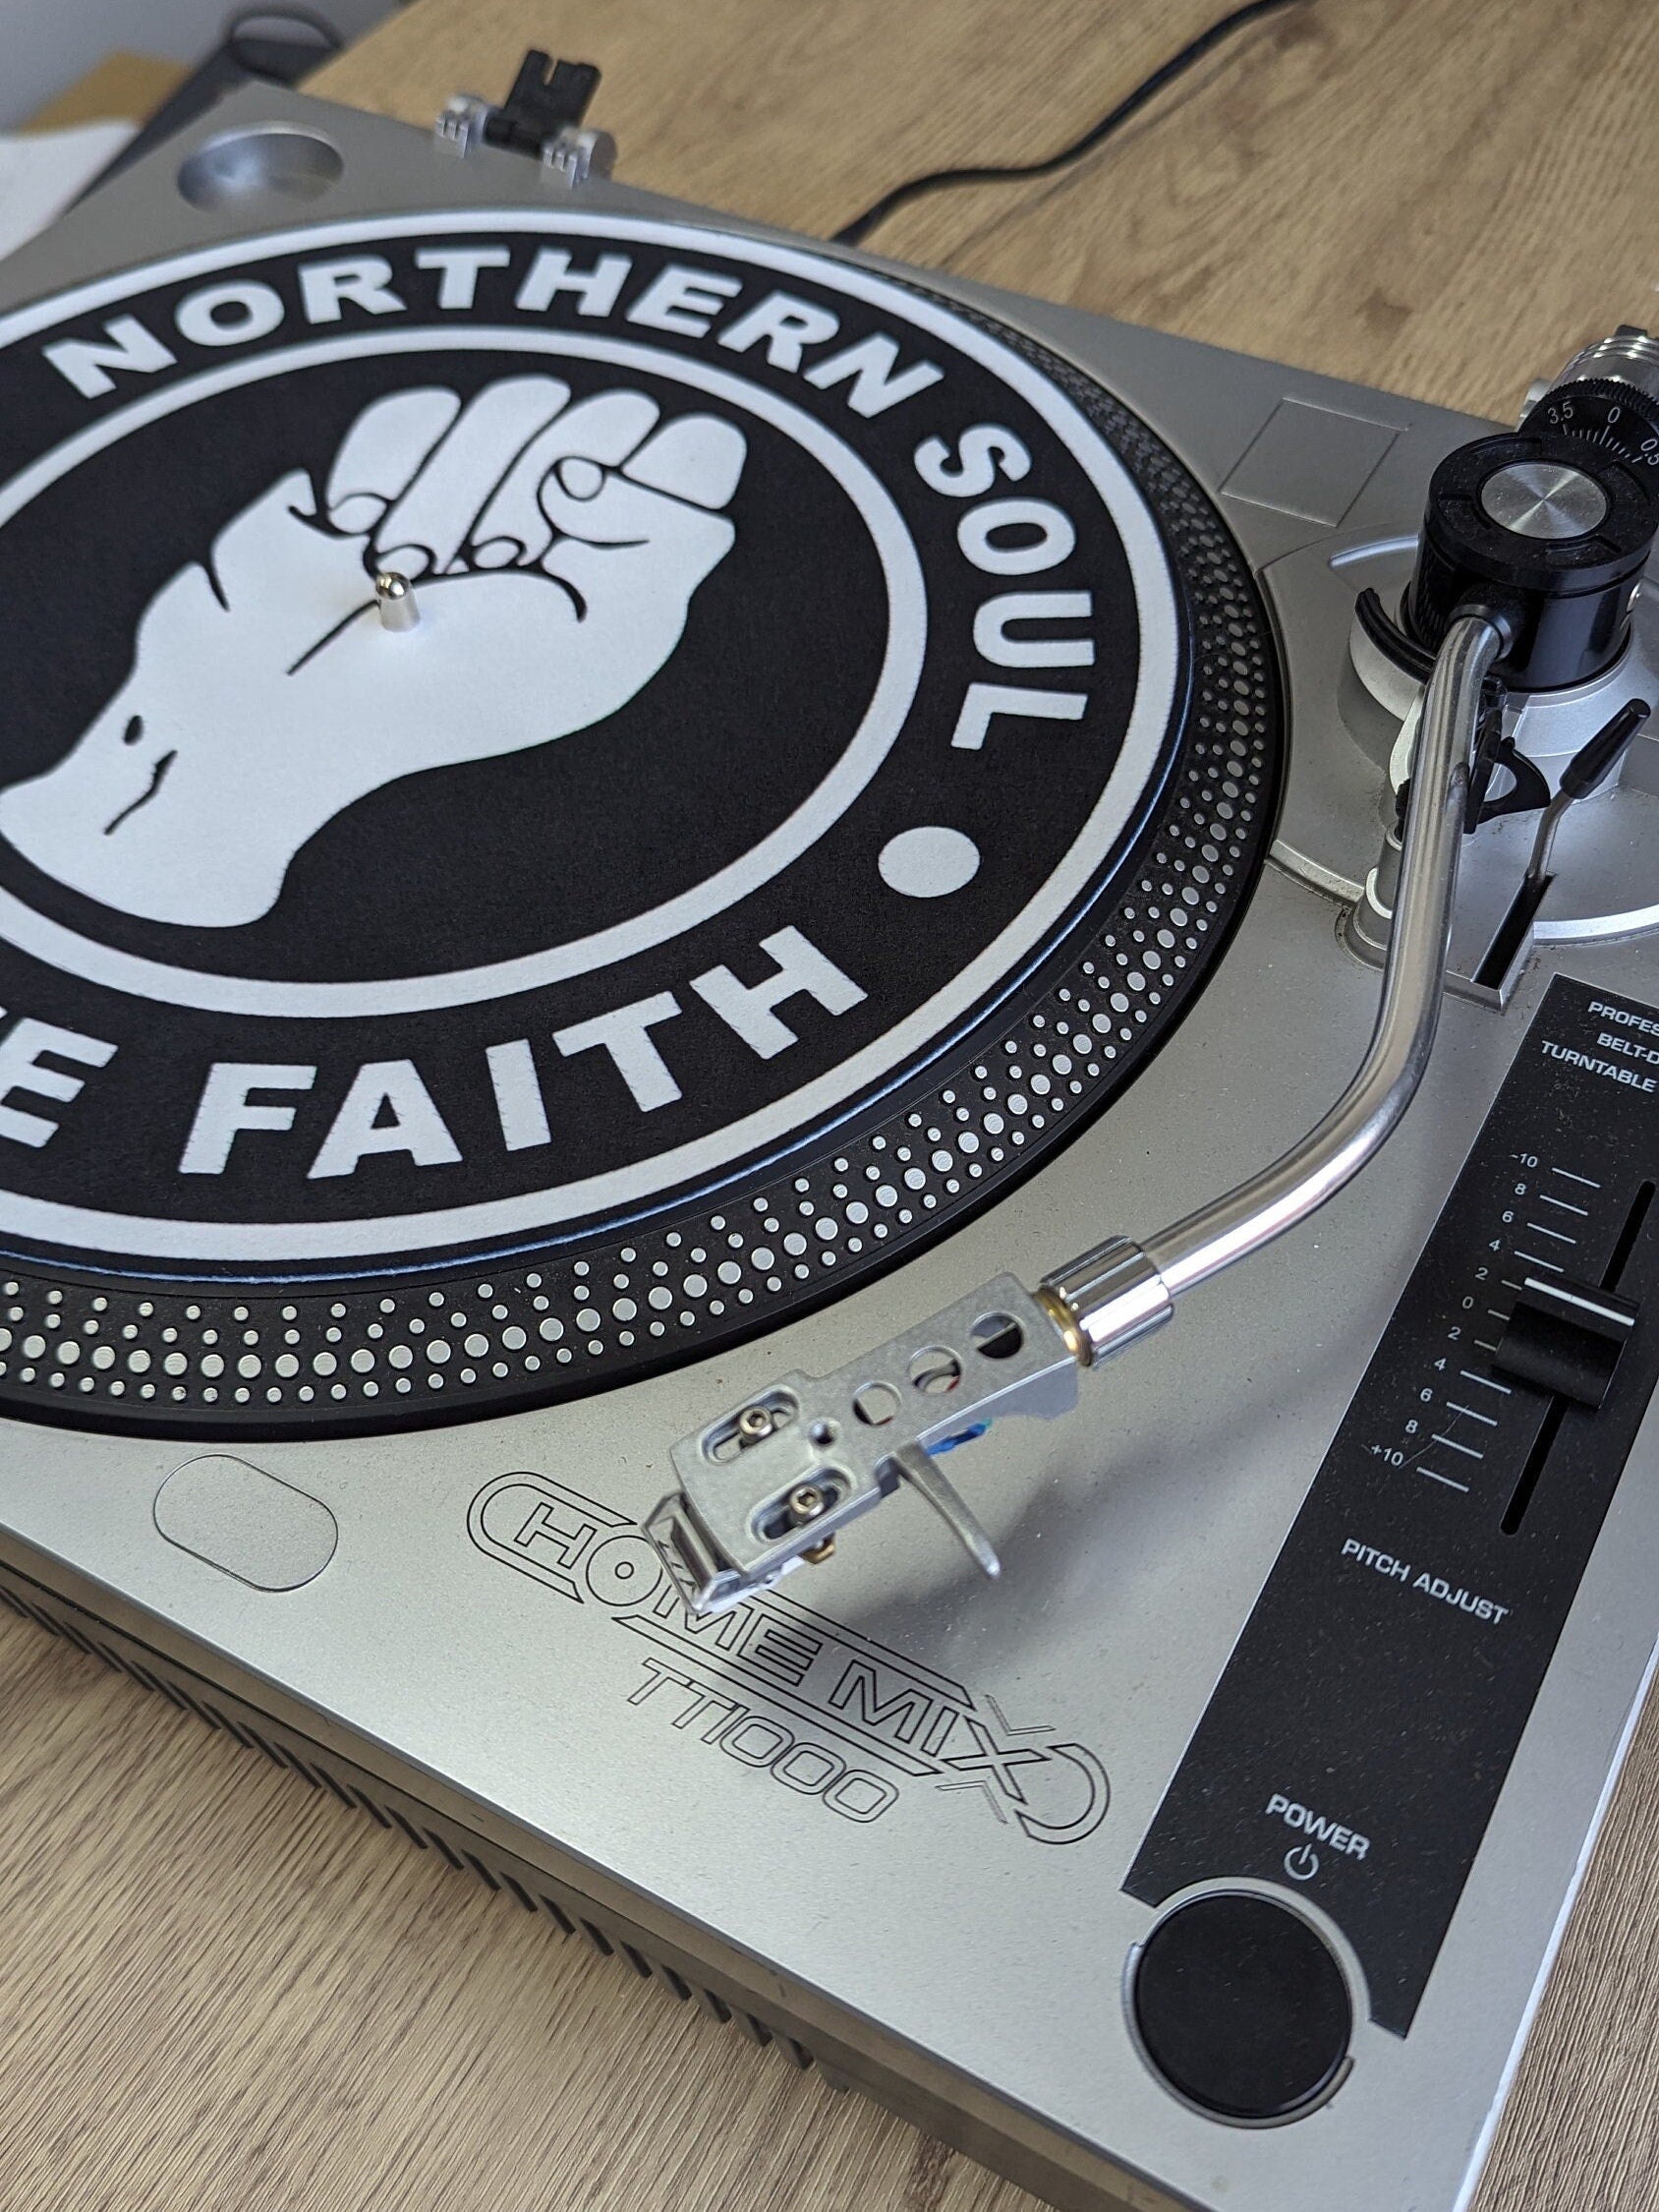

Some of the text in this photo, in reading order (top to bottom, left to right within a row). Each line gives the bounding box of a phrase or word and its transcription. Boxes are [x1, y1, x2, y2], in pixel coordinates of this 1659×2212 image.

[1547, 400, 1573, 425] 3.5
[1607, 406, 1621, 424] 0
[42, 245, 1097, 752] NORTHERN SOUL
[0, 923, 870, 1180] E FAITH
[1596, 1032, 1659, 1065] BELT-D
[1541, 1040, 1658, 1093] TURNTABLE
[1510, 1152, 1538, 1169] -10
[1515, 1183, 1526, 1195] 8
[1502, 1210, 1514, 1223] 6
[1489, 1239, 1501, 1252] 4
[1475, 1266, 1488, 1280] 2
[1461, 1296, 1474, 1310] 0
[1448, 1326, 1461, 1340] 2
[1434, 1358, 1447, 1370] 4
[1419, 1387, 1433, 1402] 6
[1405, 1419, 1418, 1434] 8
[1370, 1444, 1403, 1467] +10
[1341, 1538, 1510, 1624] PITCH ADJUST
[627, 1657, 899, 1824] TT1000
[830, 1659, 1051, 1805] MIX
[1265, 1793, 1371, 1860] POWER
